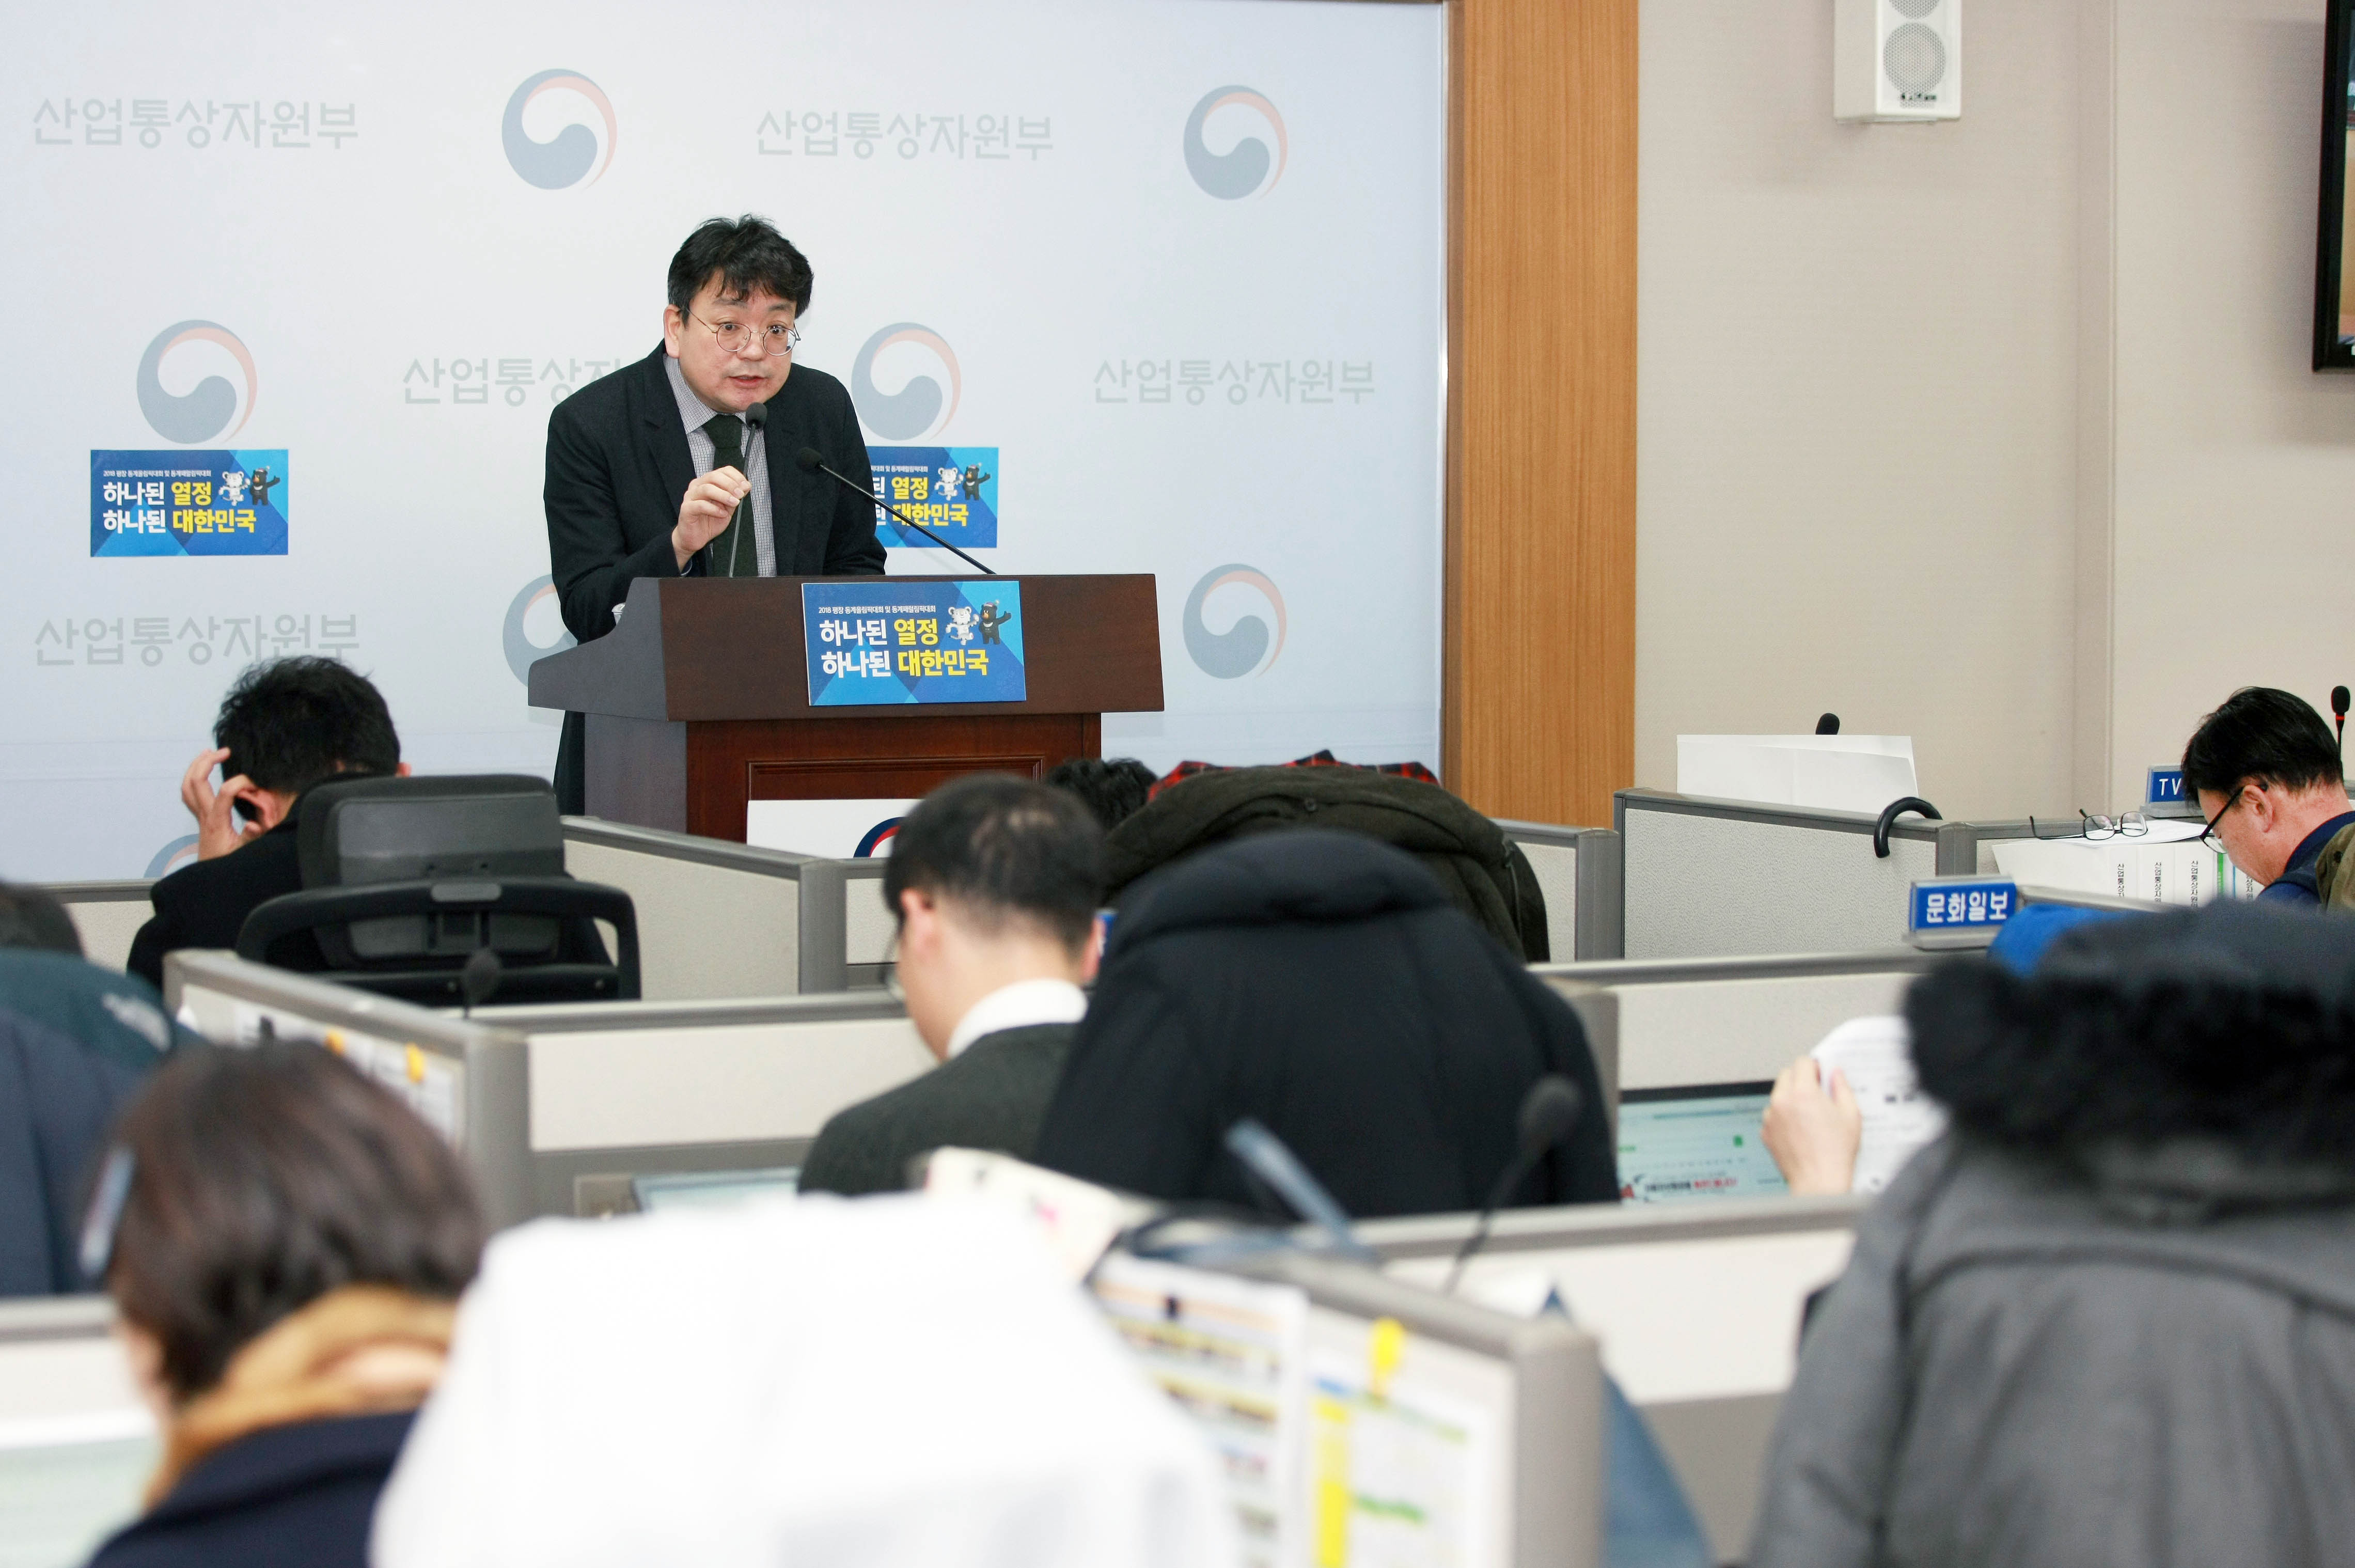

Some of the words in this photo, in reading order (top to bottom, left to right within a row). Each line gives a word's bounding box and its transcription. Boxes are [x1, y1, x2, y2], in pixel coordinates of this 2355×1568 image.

[34, 98, 358, 149] 산업통상자원부
[756, 110, 1054, 161] 산업통상자원부
[1093, 359, 1375, 406] 산업통상자원부
[103, 481, 165, 506] 하나된
[171, 481, 212, 506] 열정
[891, 477, 929, 500] 열정
[103, 509, 166, 534] 하나된
[173, 509, 257, 534] 대한민국
[892, 503, 969, 527] 대한민국
[845, 606, 884, 614] 동계올림픽대회
[35, 614, 359, 667] 산업통상자원부
[819, 619, 888, 647] 하나된
[894, 618, 939, 646] 열정
[821, 650, 891, 679] 하나된
[898, 649, 989, 677] 대한민국
[1926, 890, 2008, 923] 문화일보
